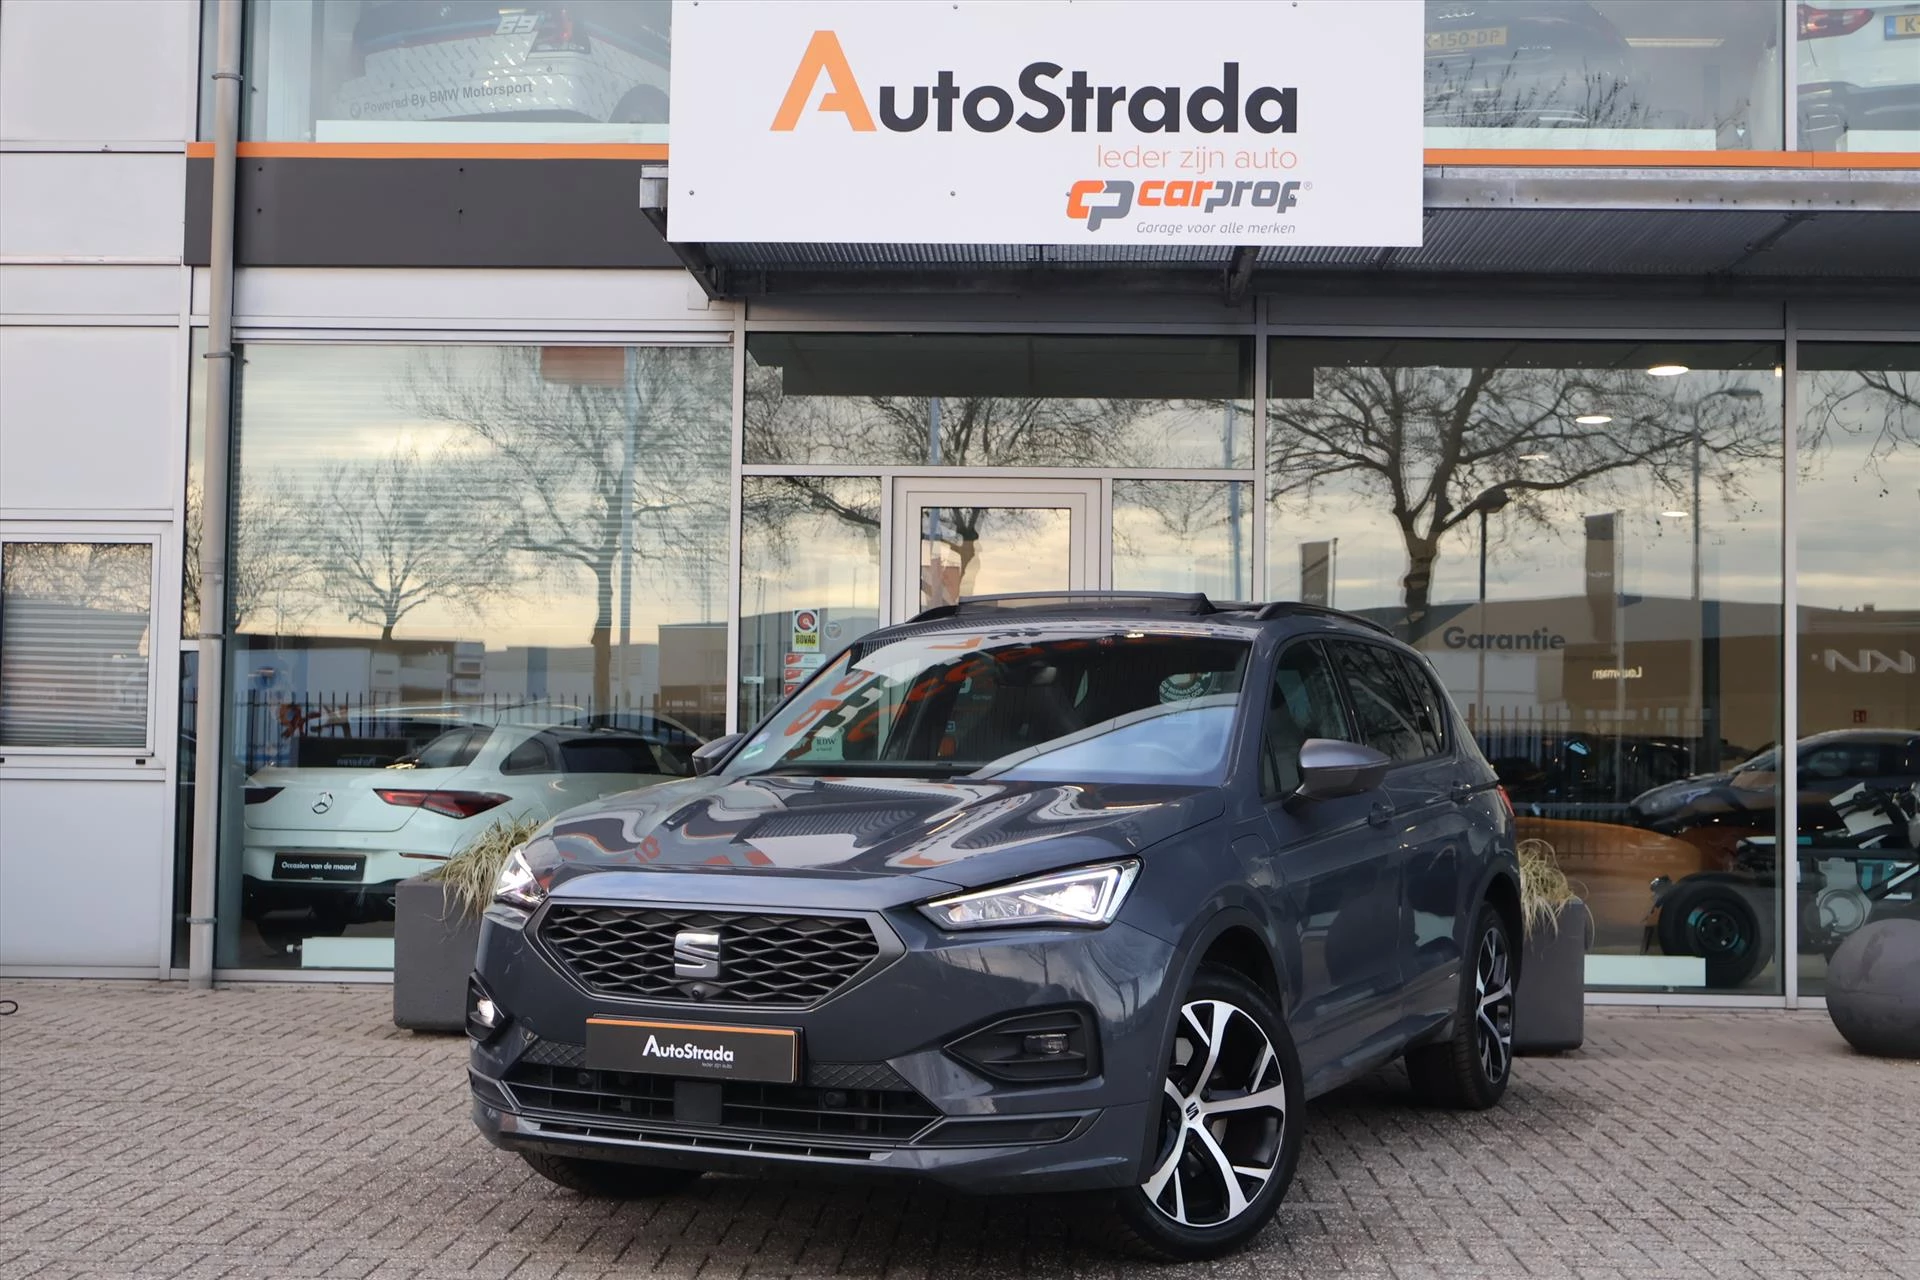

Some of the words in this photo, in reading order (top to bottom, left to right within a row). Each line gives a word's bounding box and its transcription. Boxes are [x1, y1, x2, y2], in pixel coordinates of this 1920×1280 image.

[769, 30, 1298, 134] AutoStrada
[364, 99, 408, 113] Powered
[411, 93, 426, 108] By
[429, 88, 459, 104] BMW
[462, 81, 533, 99] Motorsport
[1097, 144, 1171, 169] Ieder
[1180, 146, 1225, 175] zijn
[1234, 147, 1298, 169] auto
[1136, 221, 1183, 237] Garage
[1187, 223, 1216, 234] voor
[1220, 220, 1244, 234] alle
[1248, 222, 1296, 234] merken
[795, 634, 816, 645] BOVAG
[1443, 626, 1566, 650] Garantie
[281, 861, 310, 869] Occasion
[323, 862, 332, 870] de
[333, 863, 357, 871] maand
[642, 1034, 734, 1062] AutoStrada
